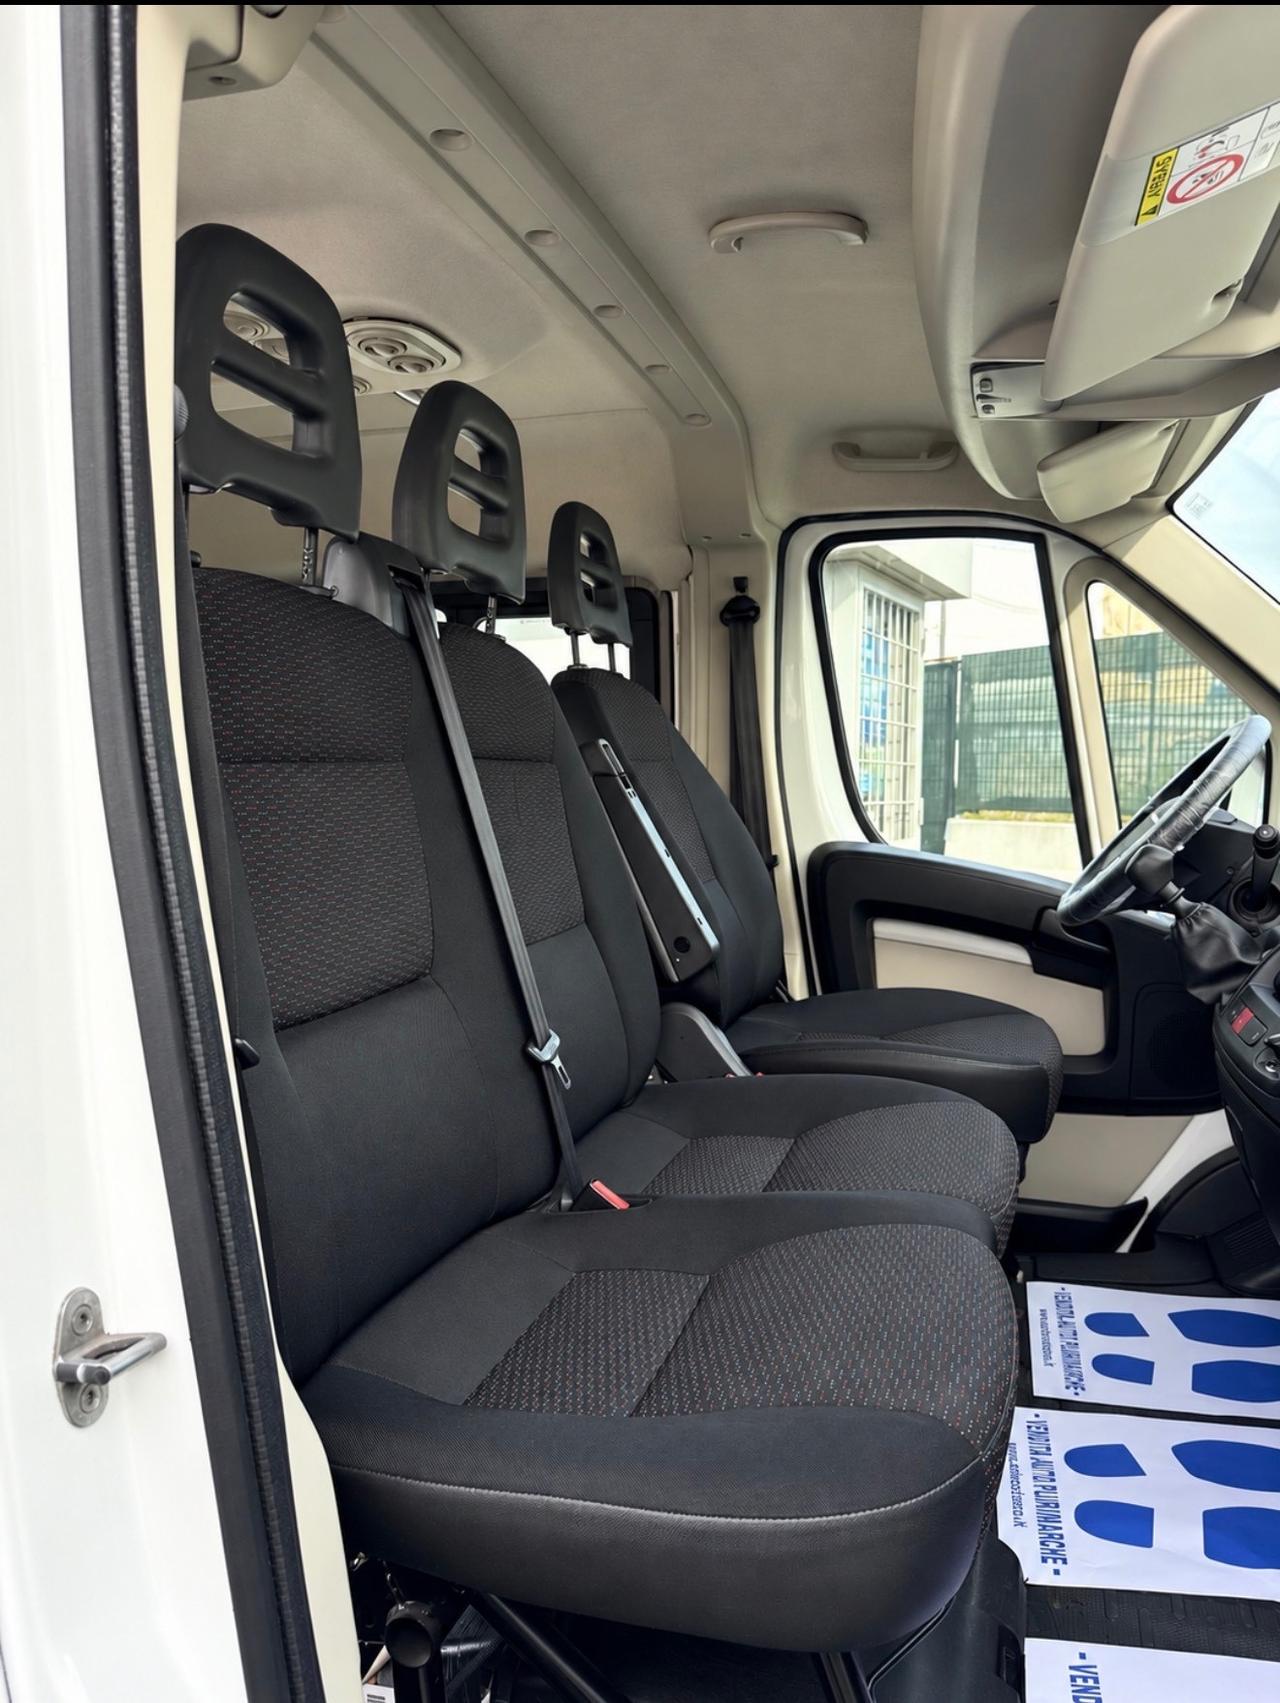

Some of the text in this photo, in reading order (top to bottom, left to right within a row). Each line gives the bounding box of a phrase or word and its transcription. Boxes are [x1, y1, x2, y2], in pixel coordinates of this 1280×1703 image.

[1026, 1420, 1052, 1456] VENDITA
[1030, 1456, 1056, 1483] AUTO
[1033, 1484, 1068, 1565] PLURIMARCHE
